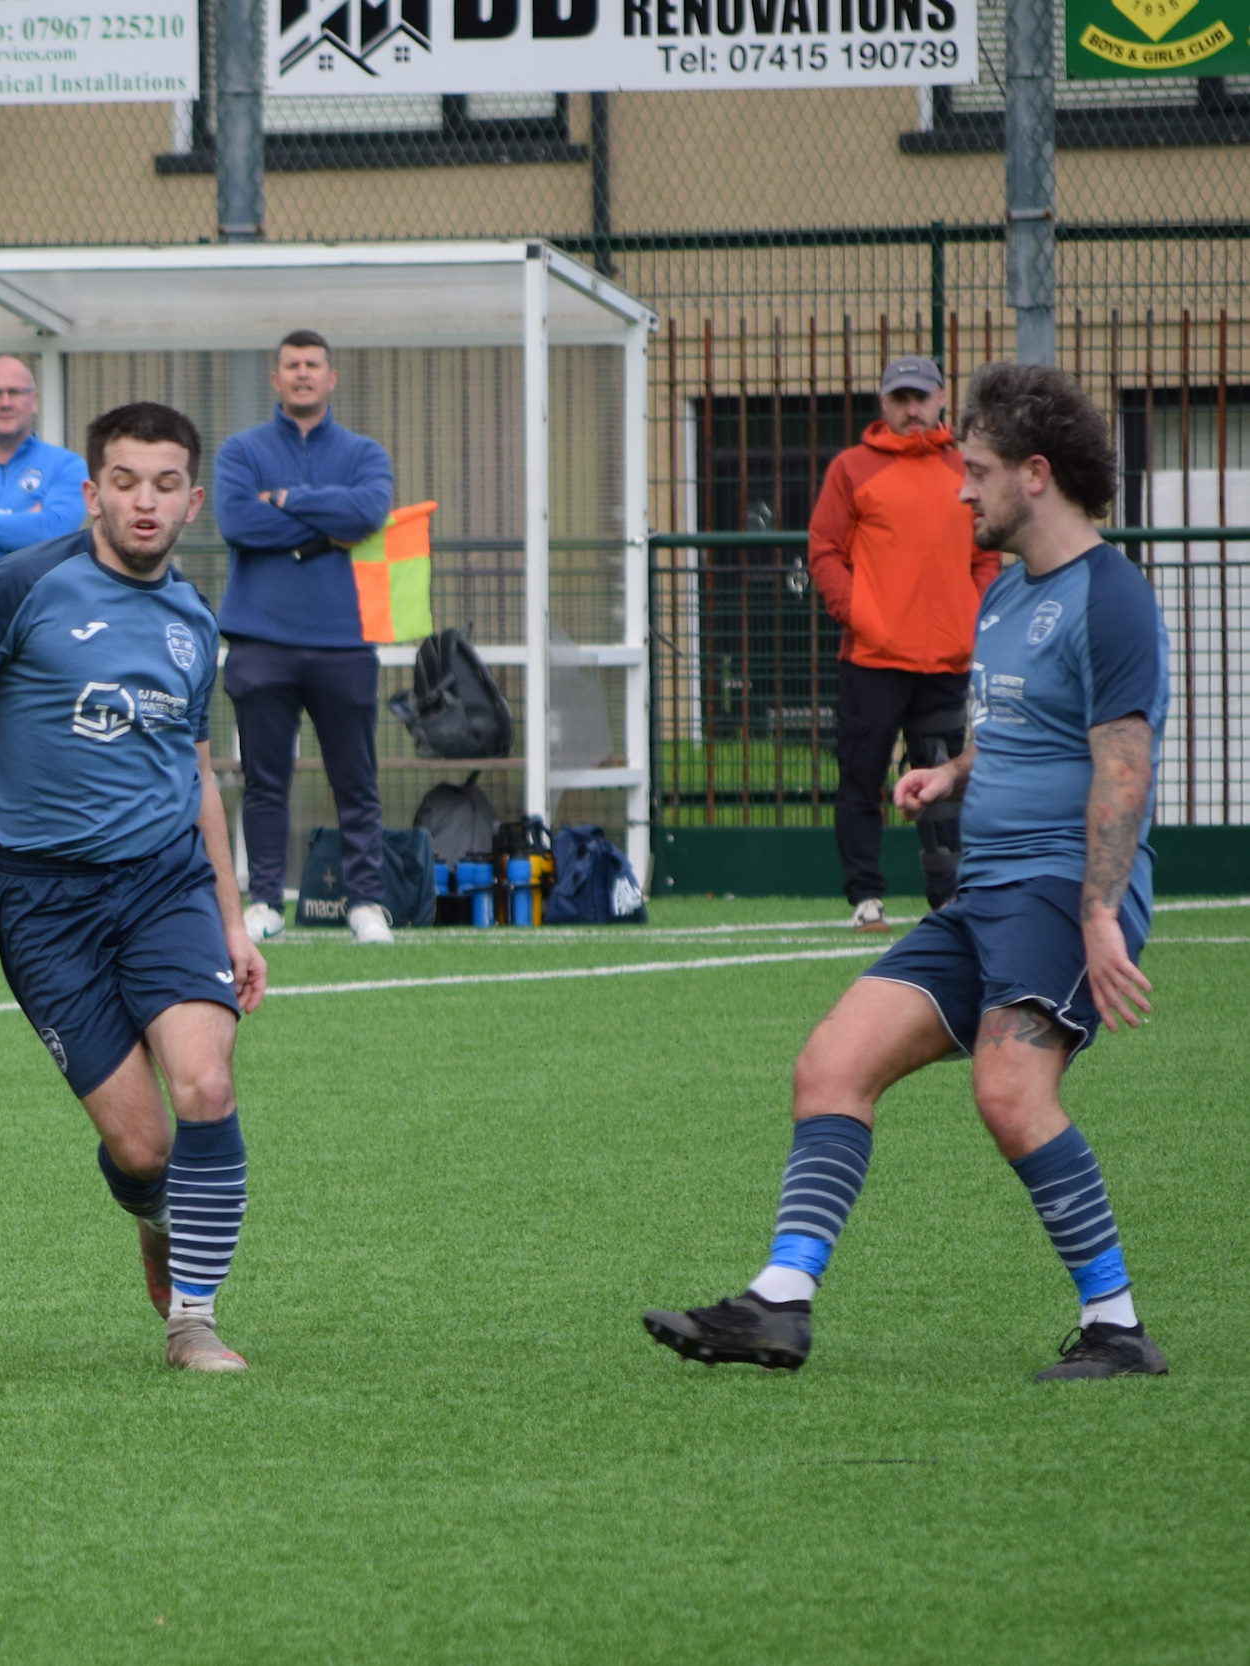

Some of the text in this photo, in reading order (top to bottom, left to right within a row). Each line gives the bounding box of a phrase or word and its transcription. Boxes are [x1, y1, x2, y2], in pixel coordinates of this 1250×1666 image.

[22, 16, 92, 41] 07967
[100, 13, 186, 40] 225210
[657, 40, 959, 73] Tel: 07415 190739
[1088, 33, 1124, 58] BOYS
[1128, 48, 1139, 61] &
[1143, 48, 1186, 64] GIRLS
[1189, 29, 1227, 56] CLUB
[51, 71, 187, 93] Installations
